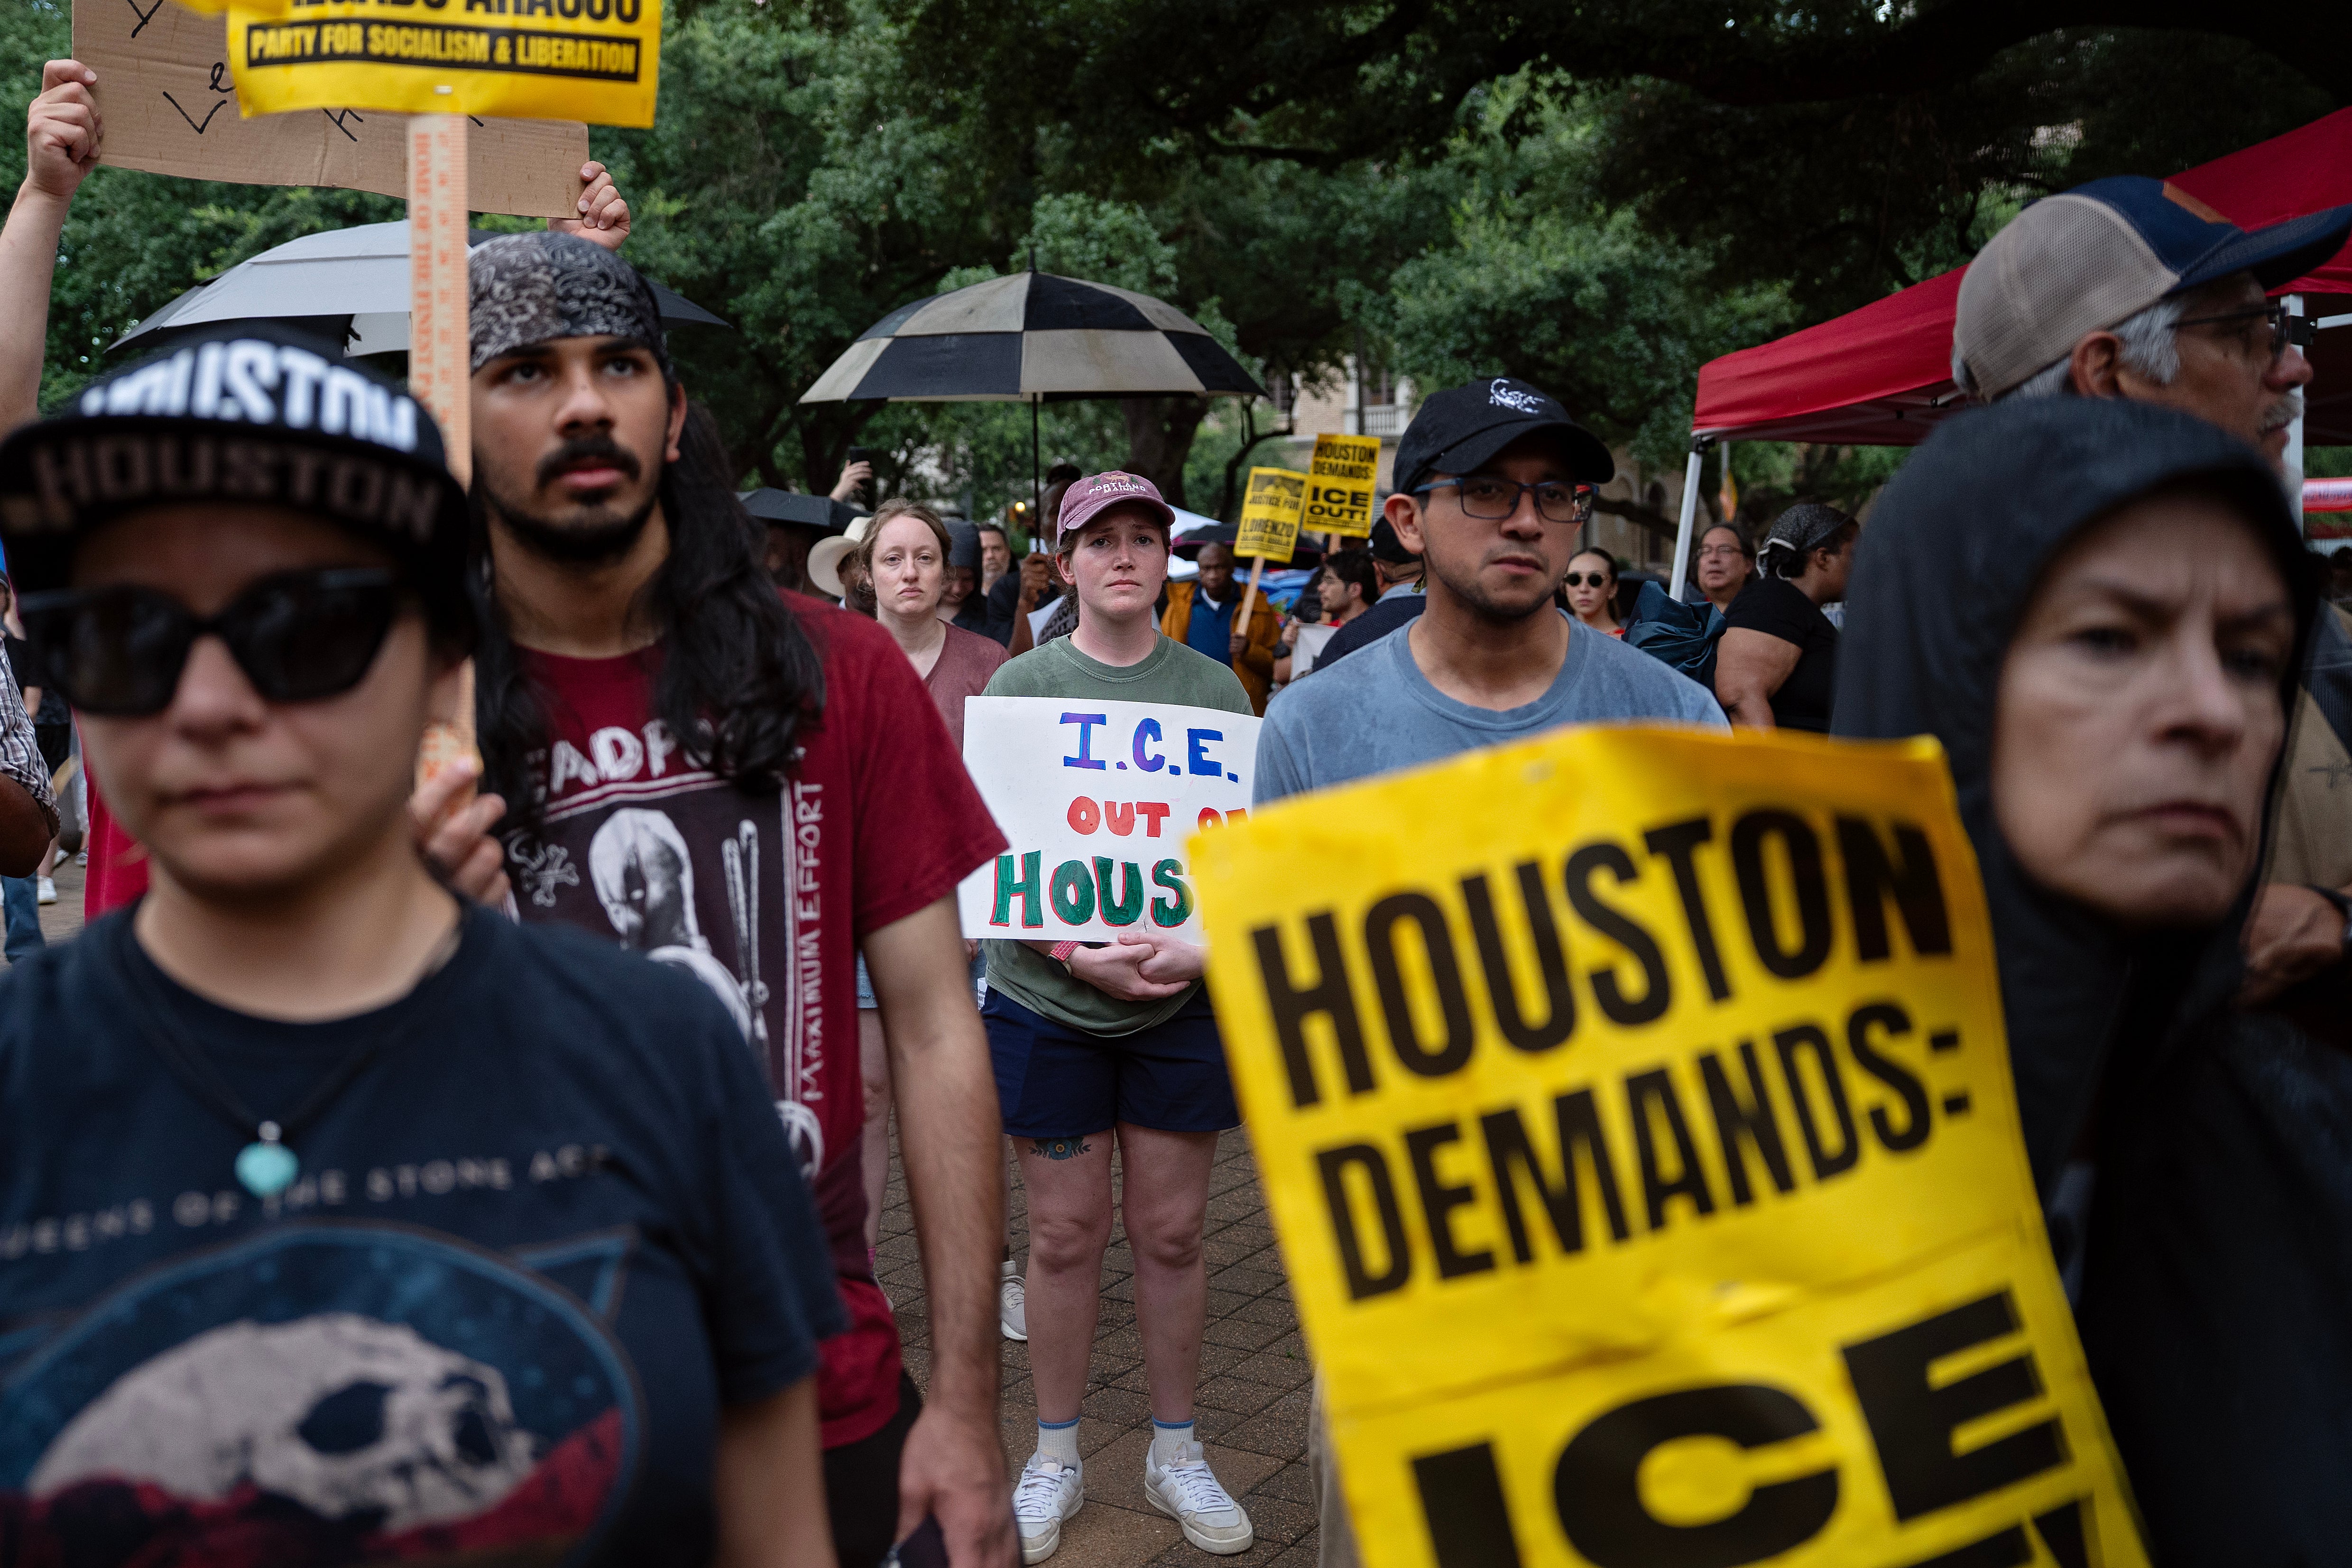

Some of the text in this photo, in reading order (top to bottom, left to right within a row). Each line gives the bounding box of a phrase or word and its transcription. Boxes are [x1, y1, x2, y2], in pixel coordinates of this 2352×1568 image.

[250, 23, 636, 74] PARTY FOR SOCIALISM & LIBERATION
[1088, 482, 1146, 494] PORTLAND
[1314, 442, 1376, 463] HOUSTON
[31, 434, 443, 543] HOUSTON
[1310, 506, 1366, 520] OUT!
[1312, 487, 1369, 507] ICE
[1244, 517, 1295, 537] LORENZO
[1059, 712, 1238, 783] I.C.E.
[1067, 796, 1170, 838] OUT
[990, 850, 1196, 929] HOUS
[794, 780, 824, 1101] MAXIMUM EFFORT
[1249, 806, 1954, 1109] HOUSTON
[1315, 1003, 1970, 1301] DEMANDS:
[172, 1189, 241, 1228] OF
[365, 1157, 512, 1203] STONE
[1410, 1283, 2075, 1568] ICE
